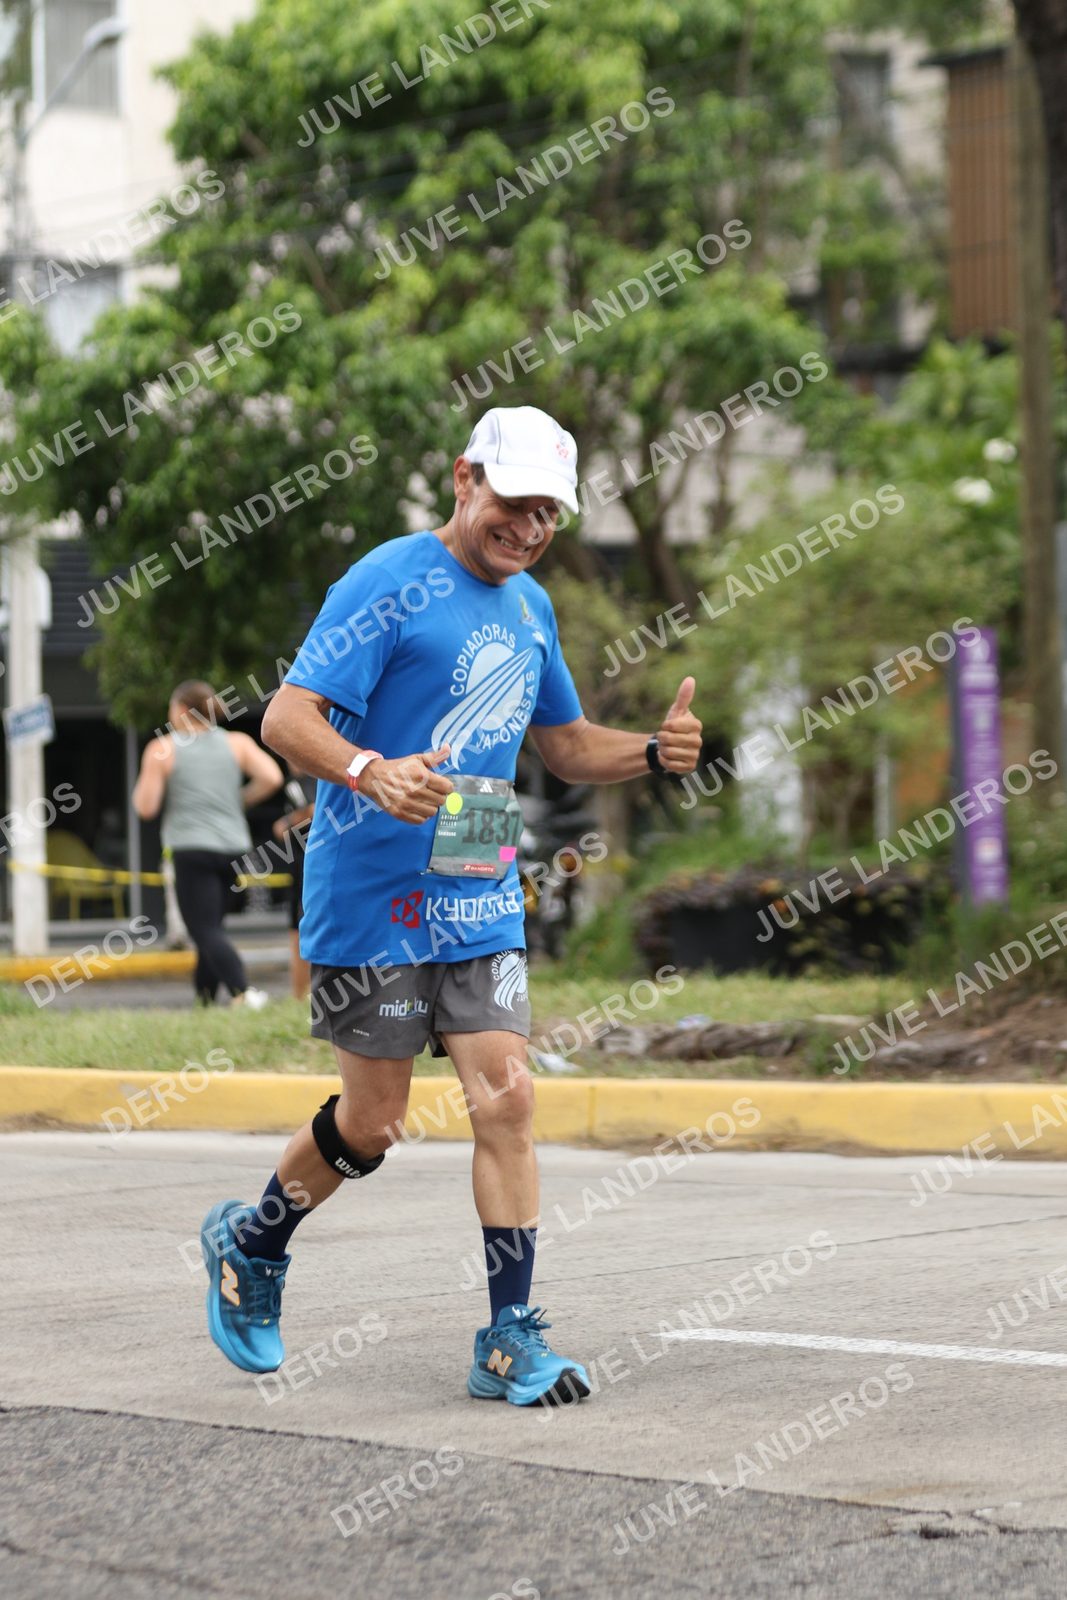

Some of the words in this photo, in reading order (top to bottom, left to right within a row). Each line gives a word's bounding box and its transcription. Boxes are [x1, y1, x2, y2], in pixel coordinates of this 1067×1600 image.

[450, 623, 516, 697] COPIADORAS
[476, 670, 536, 750] JAPONESAS
[487, 1348, 513, 1377] N
